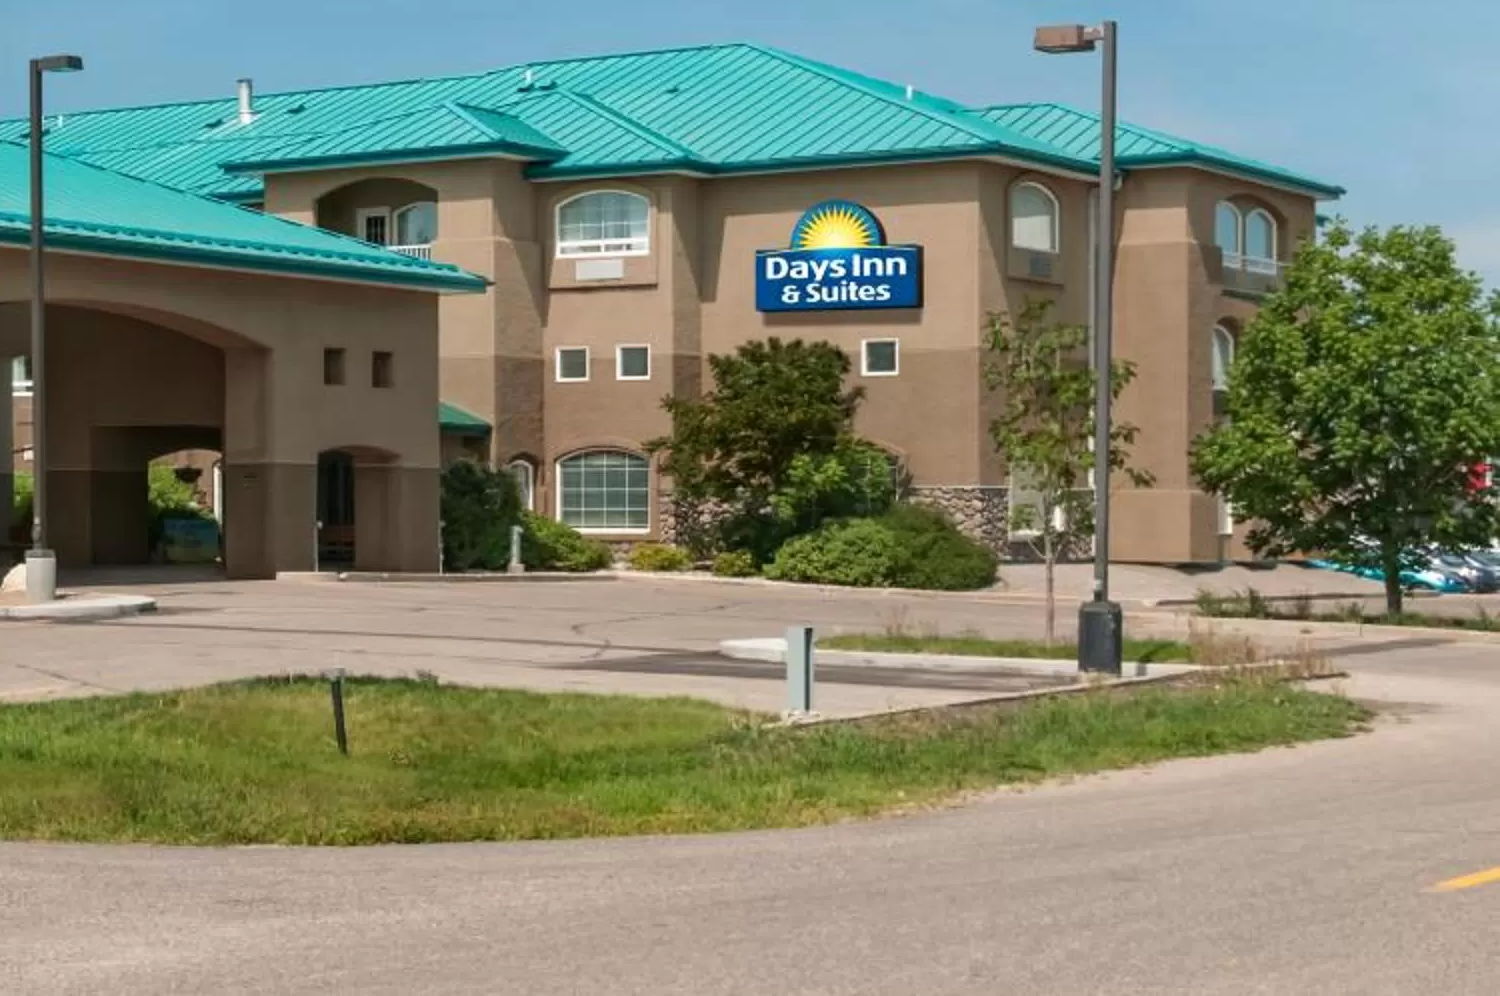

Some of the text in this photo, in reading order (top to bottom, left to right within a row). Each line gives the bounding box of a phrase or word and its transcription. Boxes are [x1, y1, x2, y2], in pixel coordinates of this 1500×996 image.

[766, 254, 907, 282] Days Inn
[781, 281, 892, 304] & Suites
